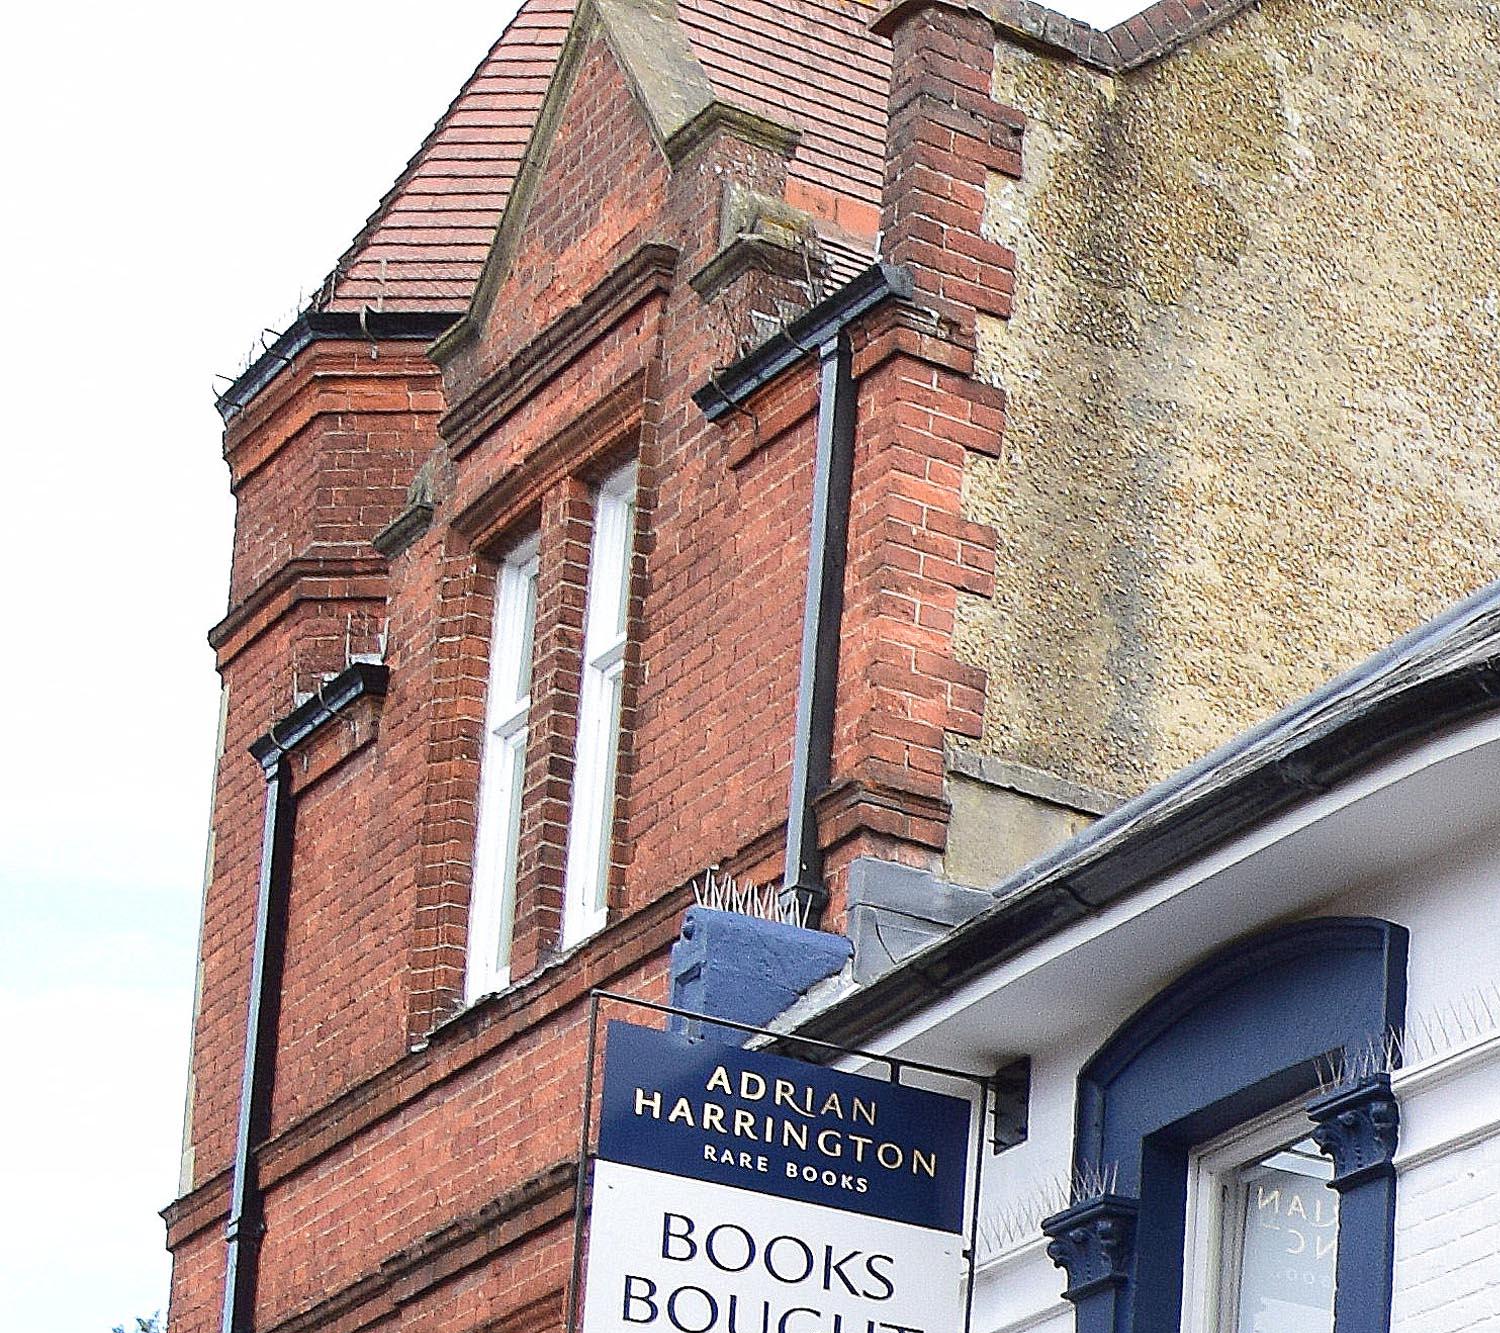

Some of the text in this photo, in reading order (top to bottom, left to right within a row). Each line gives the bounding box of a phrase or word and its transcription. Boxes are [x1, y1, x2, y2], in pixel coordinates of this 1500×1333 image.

[634, 1087, 937, 1179] HARRINGTON
[706, 1065, 877, 1126] ADRIAN
[703, 1145, 869, 1193] RARE BOOKS
[661, 1212, 895, 1302] BOOKS
